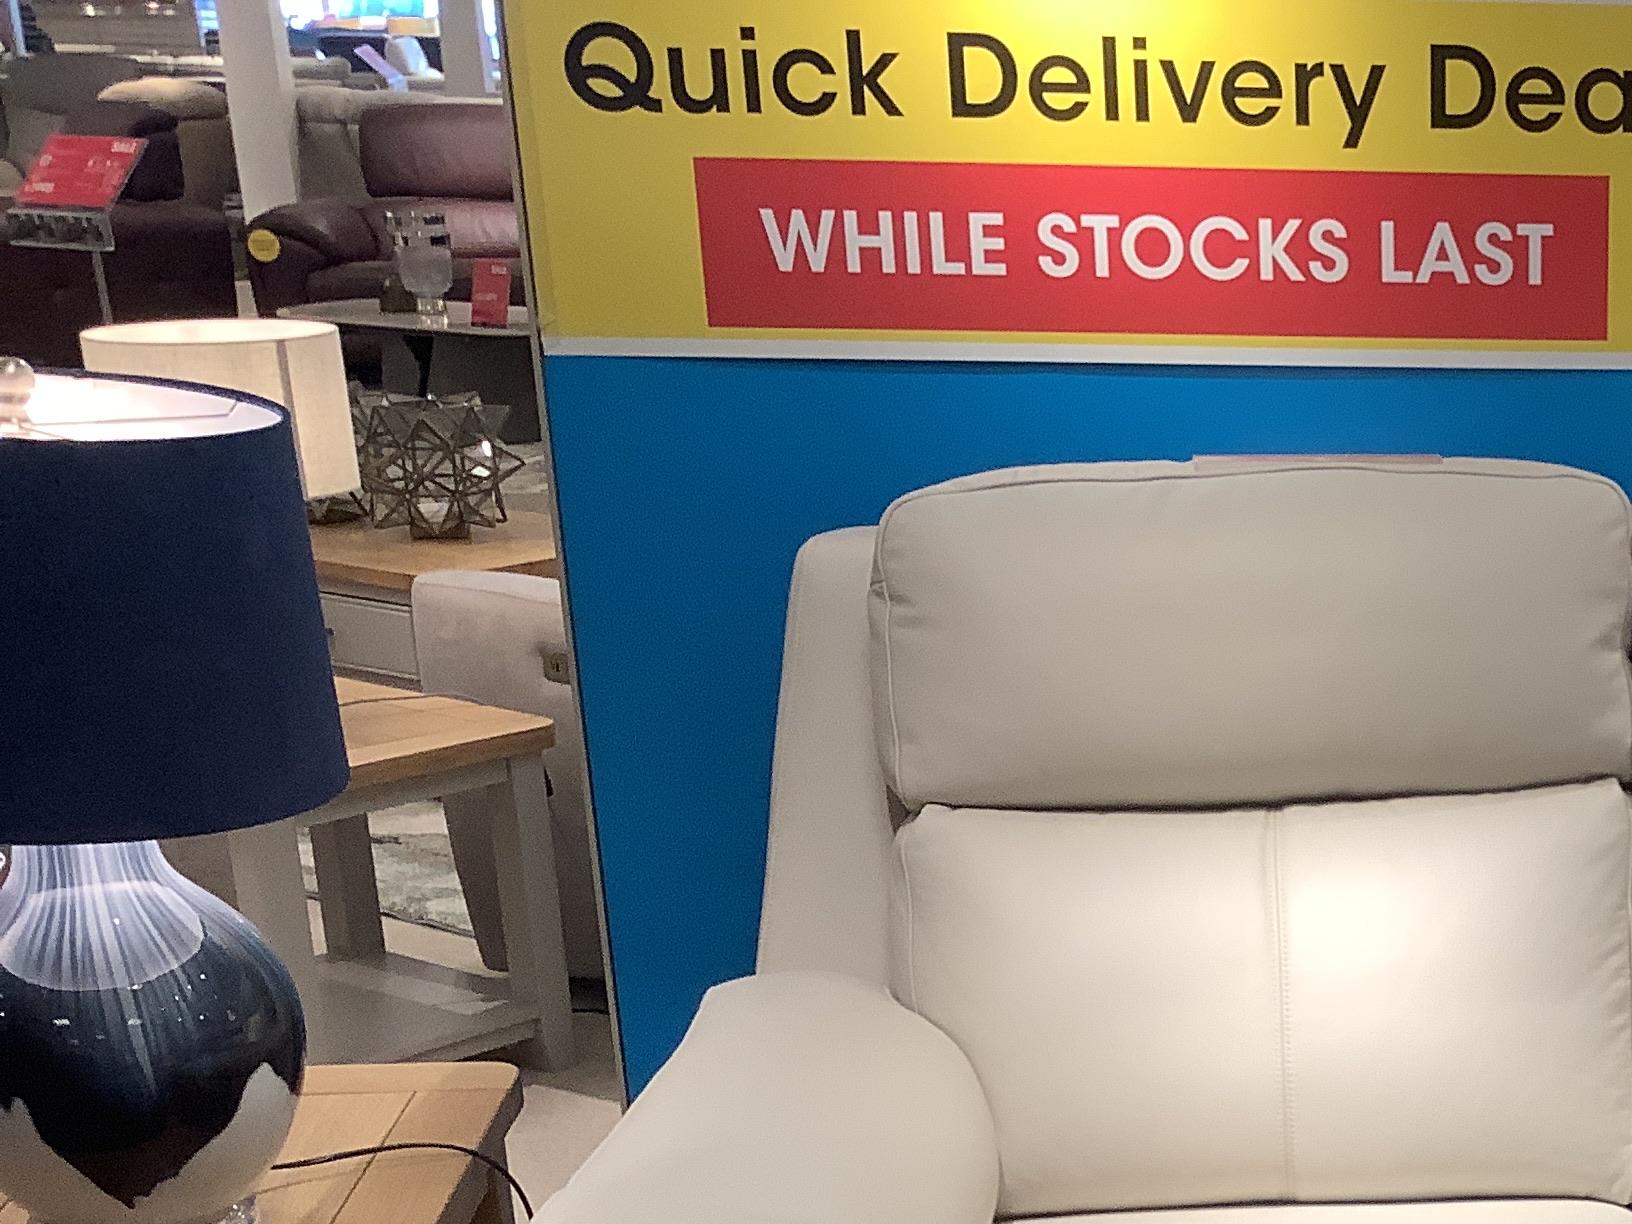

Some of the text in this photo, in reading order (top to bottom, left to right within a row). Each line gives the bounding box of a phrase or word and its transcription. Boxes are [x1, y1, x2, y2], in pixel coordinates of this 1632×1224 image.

[562, 21, 905, 117] Quick
[947, 32, 1387, 149] Delivery
[757, 207, 1555, 287] WHILE STOCKS LAST
